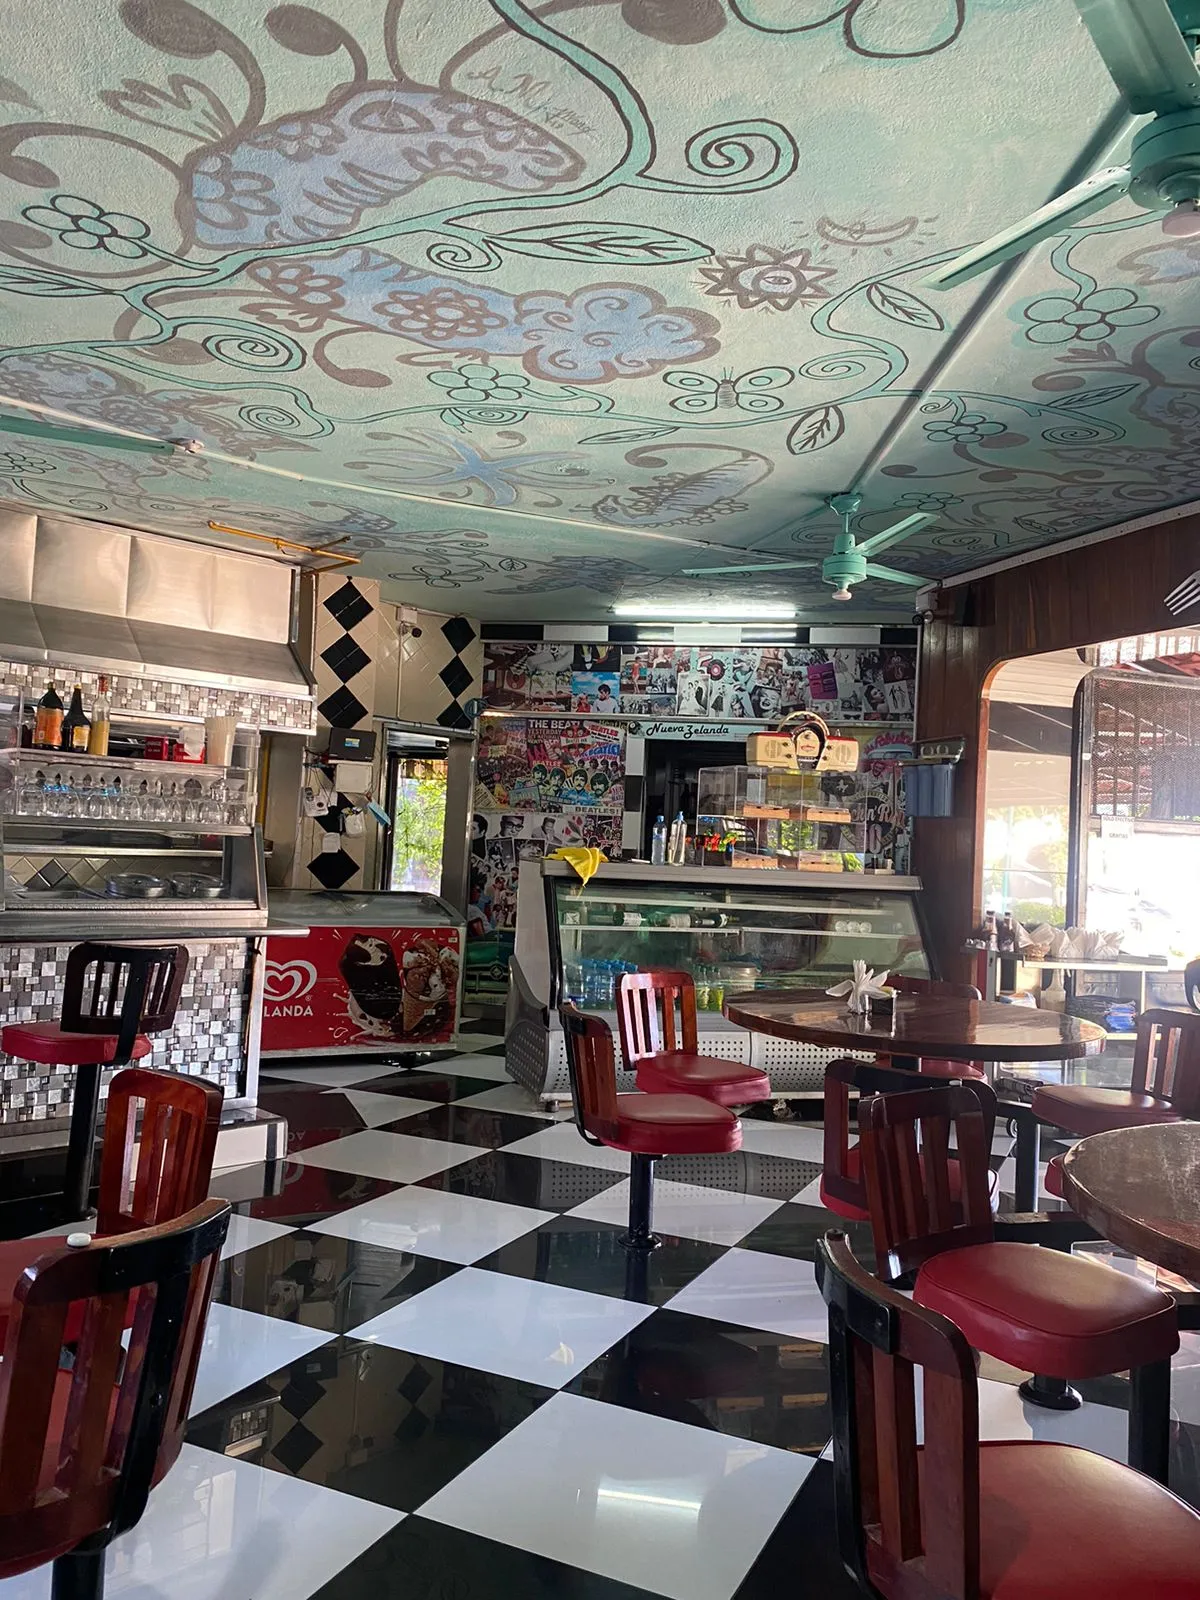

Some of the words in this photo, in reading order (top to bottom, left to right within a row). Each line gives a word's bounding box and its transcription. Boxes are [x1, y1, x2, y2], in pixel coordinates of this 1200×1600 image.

[528, 719, 548, 728] THE
[550, 720, 580, 729] BEAT
[646, 723, 684, 736] Nueva
[683, 724, 729, 739] Zelanda
[575, 806, 620, 814] BEATLES!
[263, 1005, 314, 1018] LANDA
